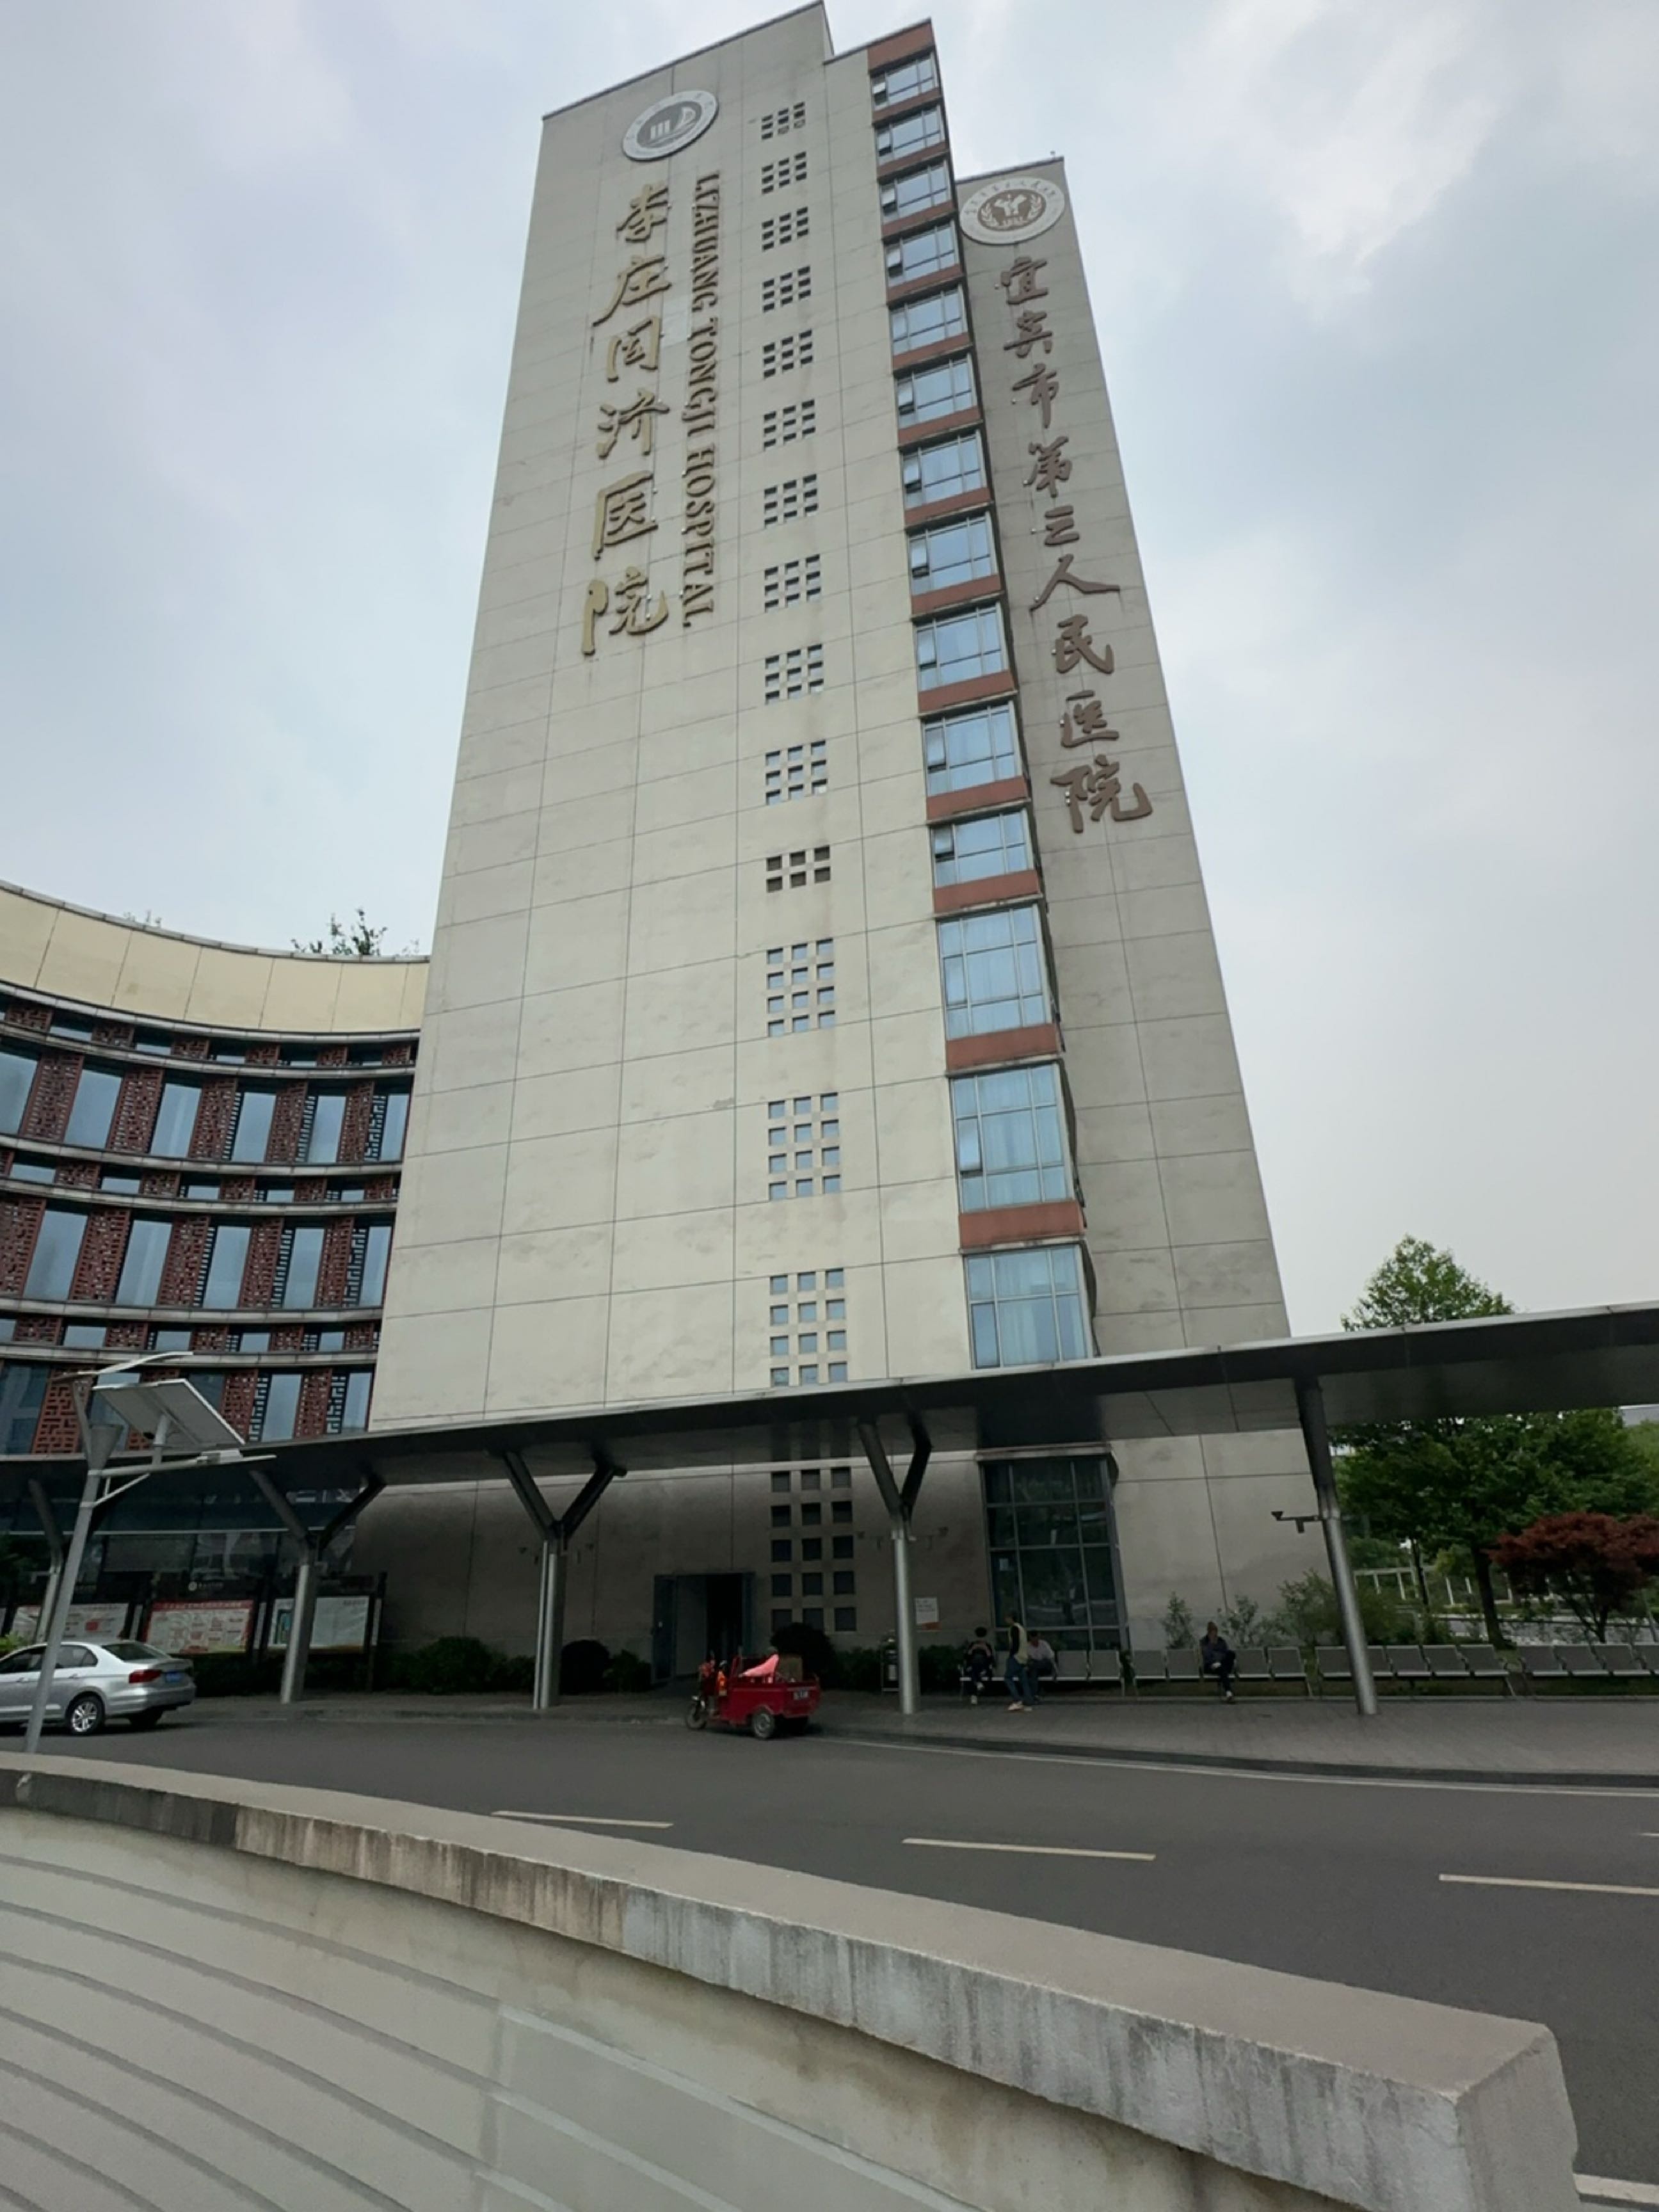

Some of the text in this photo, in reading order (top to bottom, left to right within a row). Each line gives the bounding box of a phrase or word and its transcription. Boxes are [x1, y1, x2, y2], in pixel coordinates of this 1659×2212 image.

[582, 182, 671, 655] 李庄同济医院
[680, 172, 720, 629] LIZHUANG TONGJI HOSPITAL
[1000, 256, 1153, 833] 宜宾市第三人民医院
